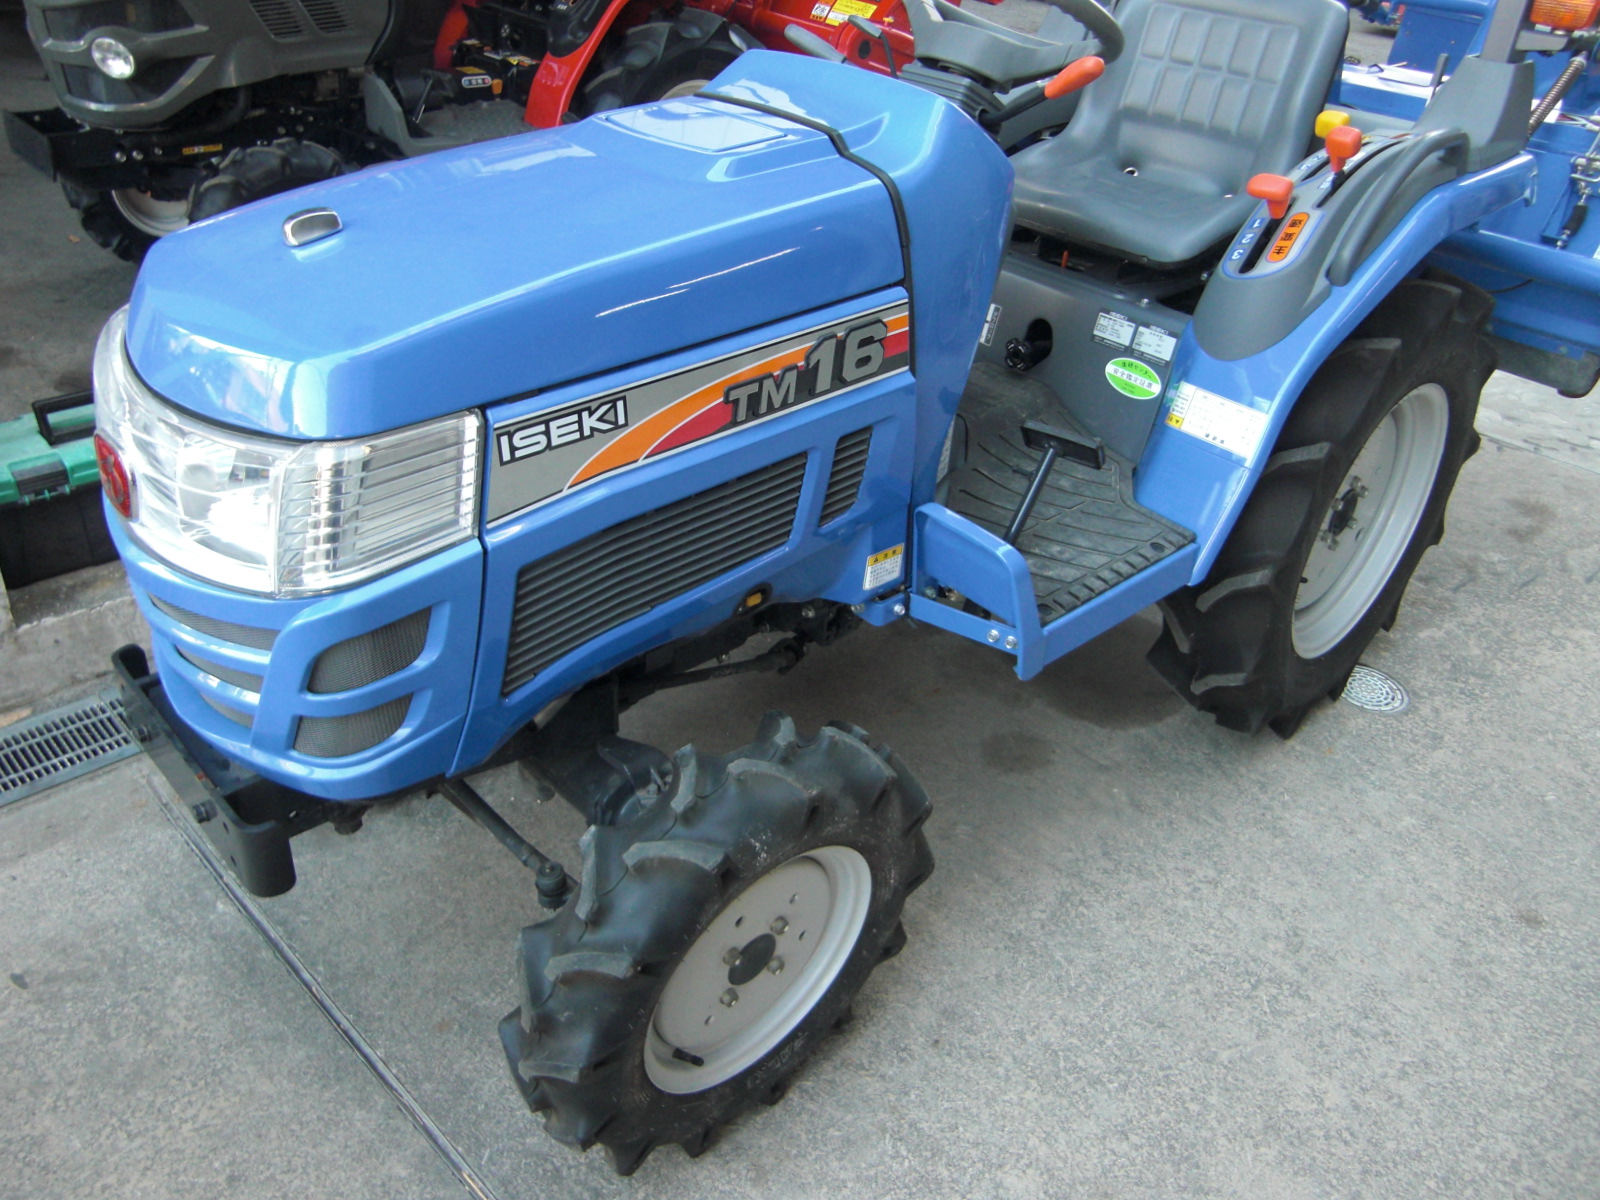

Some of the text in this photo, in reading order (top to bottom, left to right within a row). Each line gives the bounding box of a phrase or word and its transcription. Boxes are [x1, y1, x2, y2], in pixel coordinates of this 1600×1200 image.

[1252, 218, 1261, 228] 1
[1242, 233, 1254, 244] 2
[1231, 249, 1244, 260] 3
[499, 397, 627, 463] ISEKI
